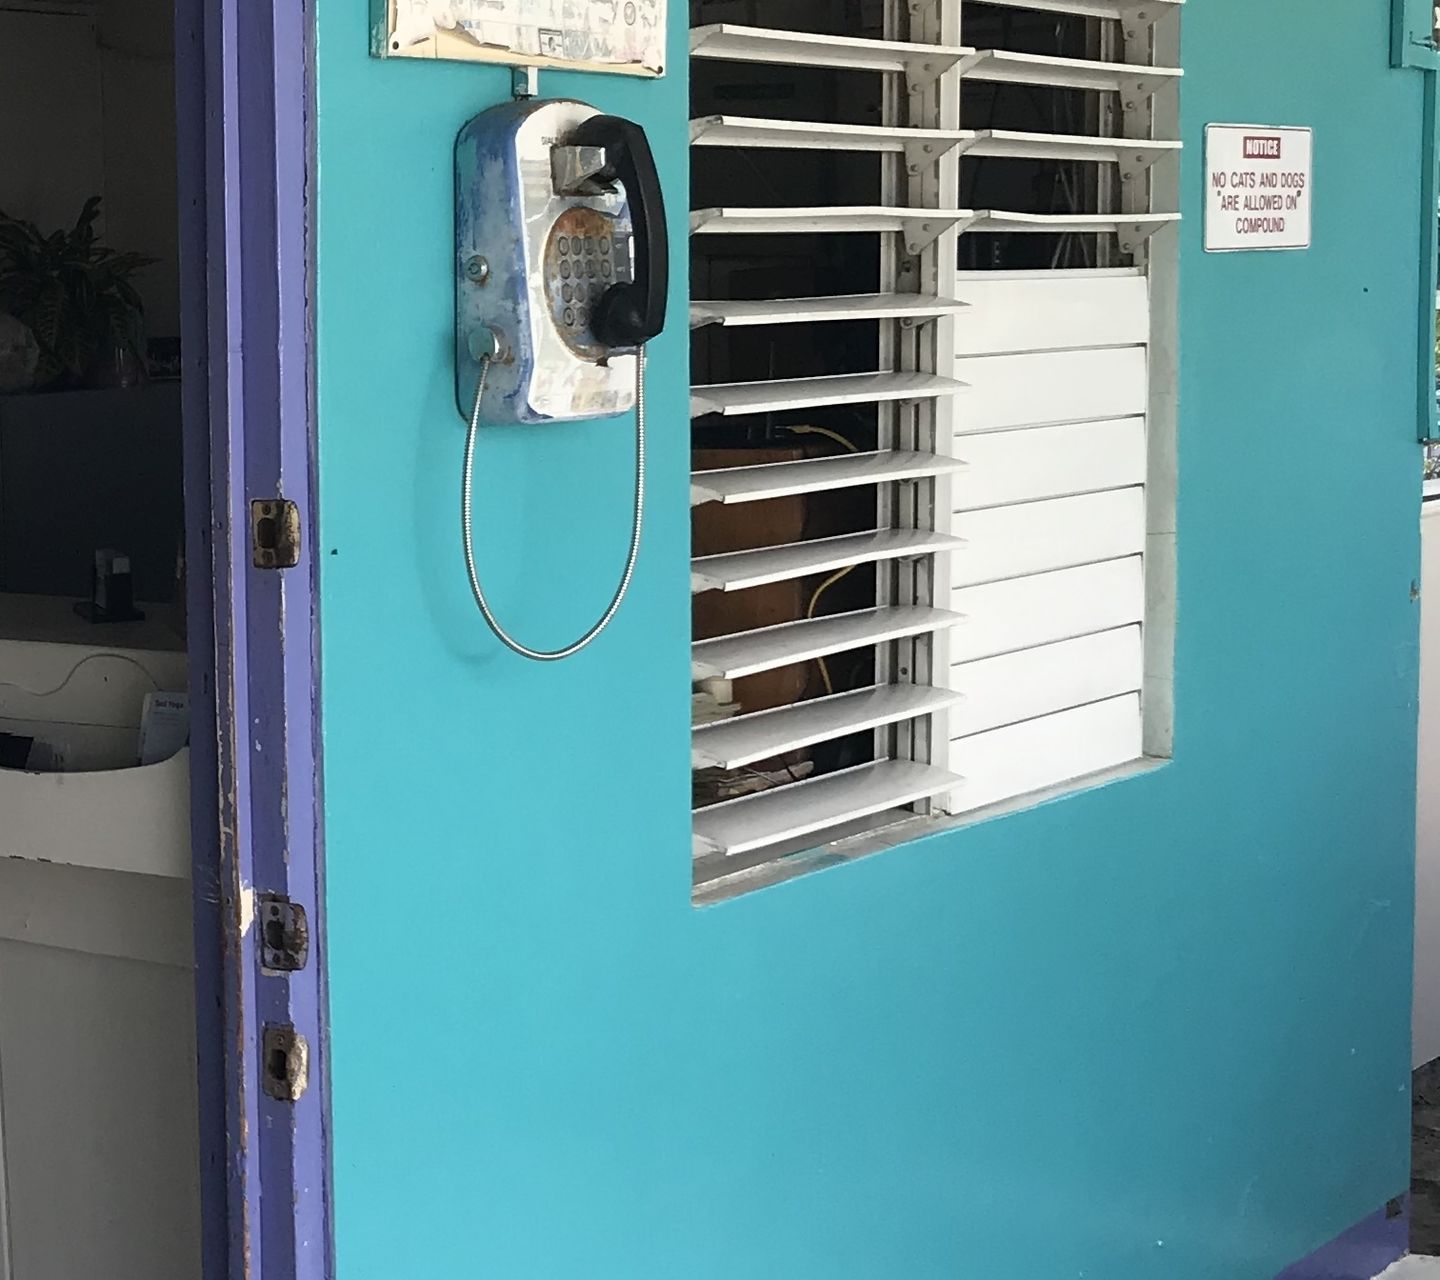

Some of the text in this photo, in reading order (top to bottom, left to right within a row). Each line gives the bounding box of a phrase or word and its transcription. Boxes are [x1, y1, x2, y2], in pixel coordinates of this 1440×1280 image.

[1246, 139, 1279, 155] NOTICE
[1212, 172, 1305, 188] NO CATS AND DOGS
[1221, 195, 1297, 211] ARE ALLOWED ON
[1235, 217, 1285, 233] COMPOUND
